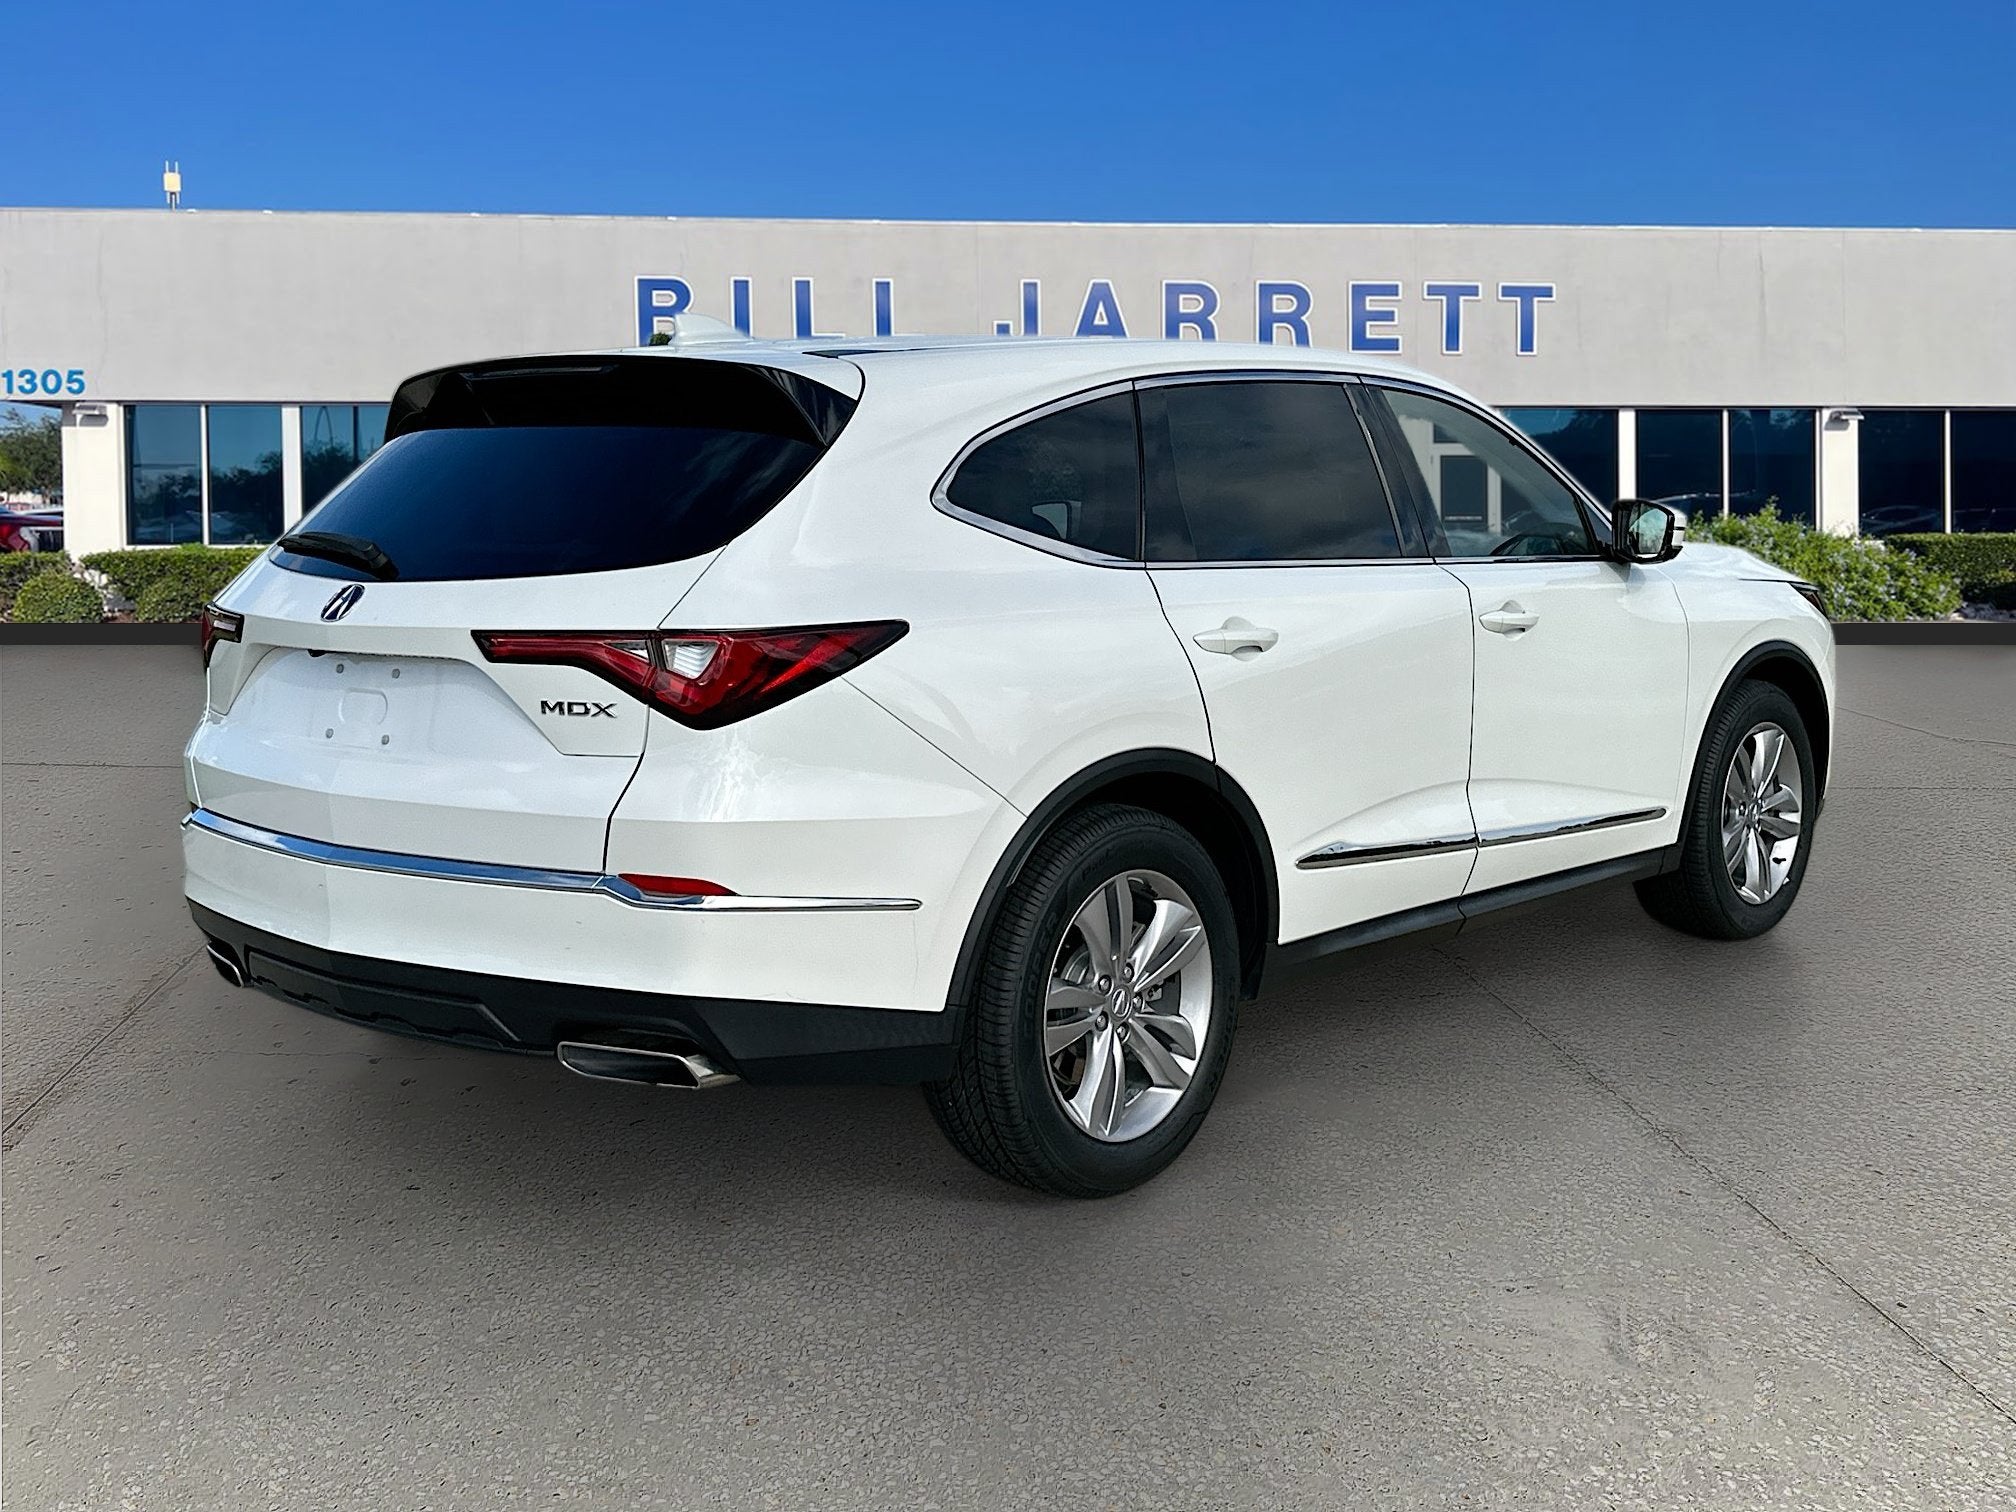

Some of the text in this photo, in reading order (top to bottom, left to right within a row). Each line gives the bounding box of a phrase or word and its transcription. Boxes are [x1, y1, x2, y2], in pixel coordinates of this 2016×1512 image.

[993, 278, 1556, 356] JARRETT
[1, 368, 86, 395] 1305
[540, 699, 618, 719] MDX
